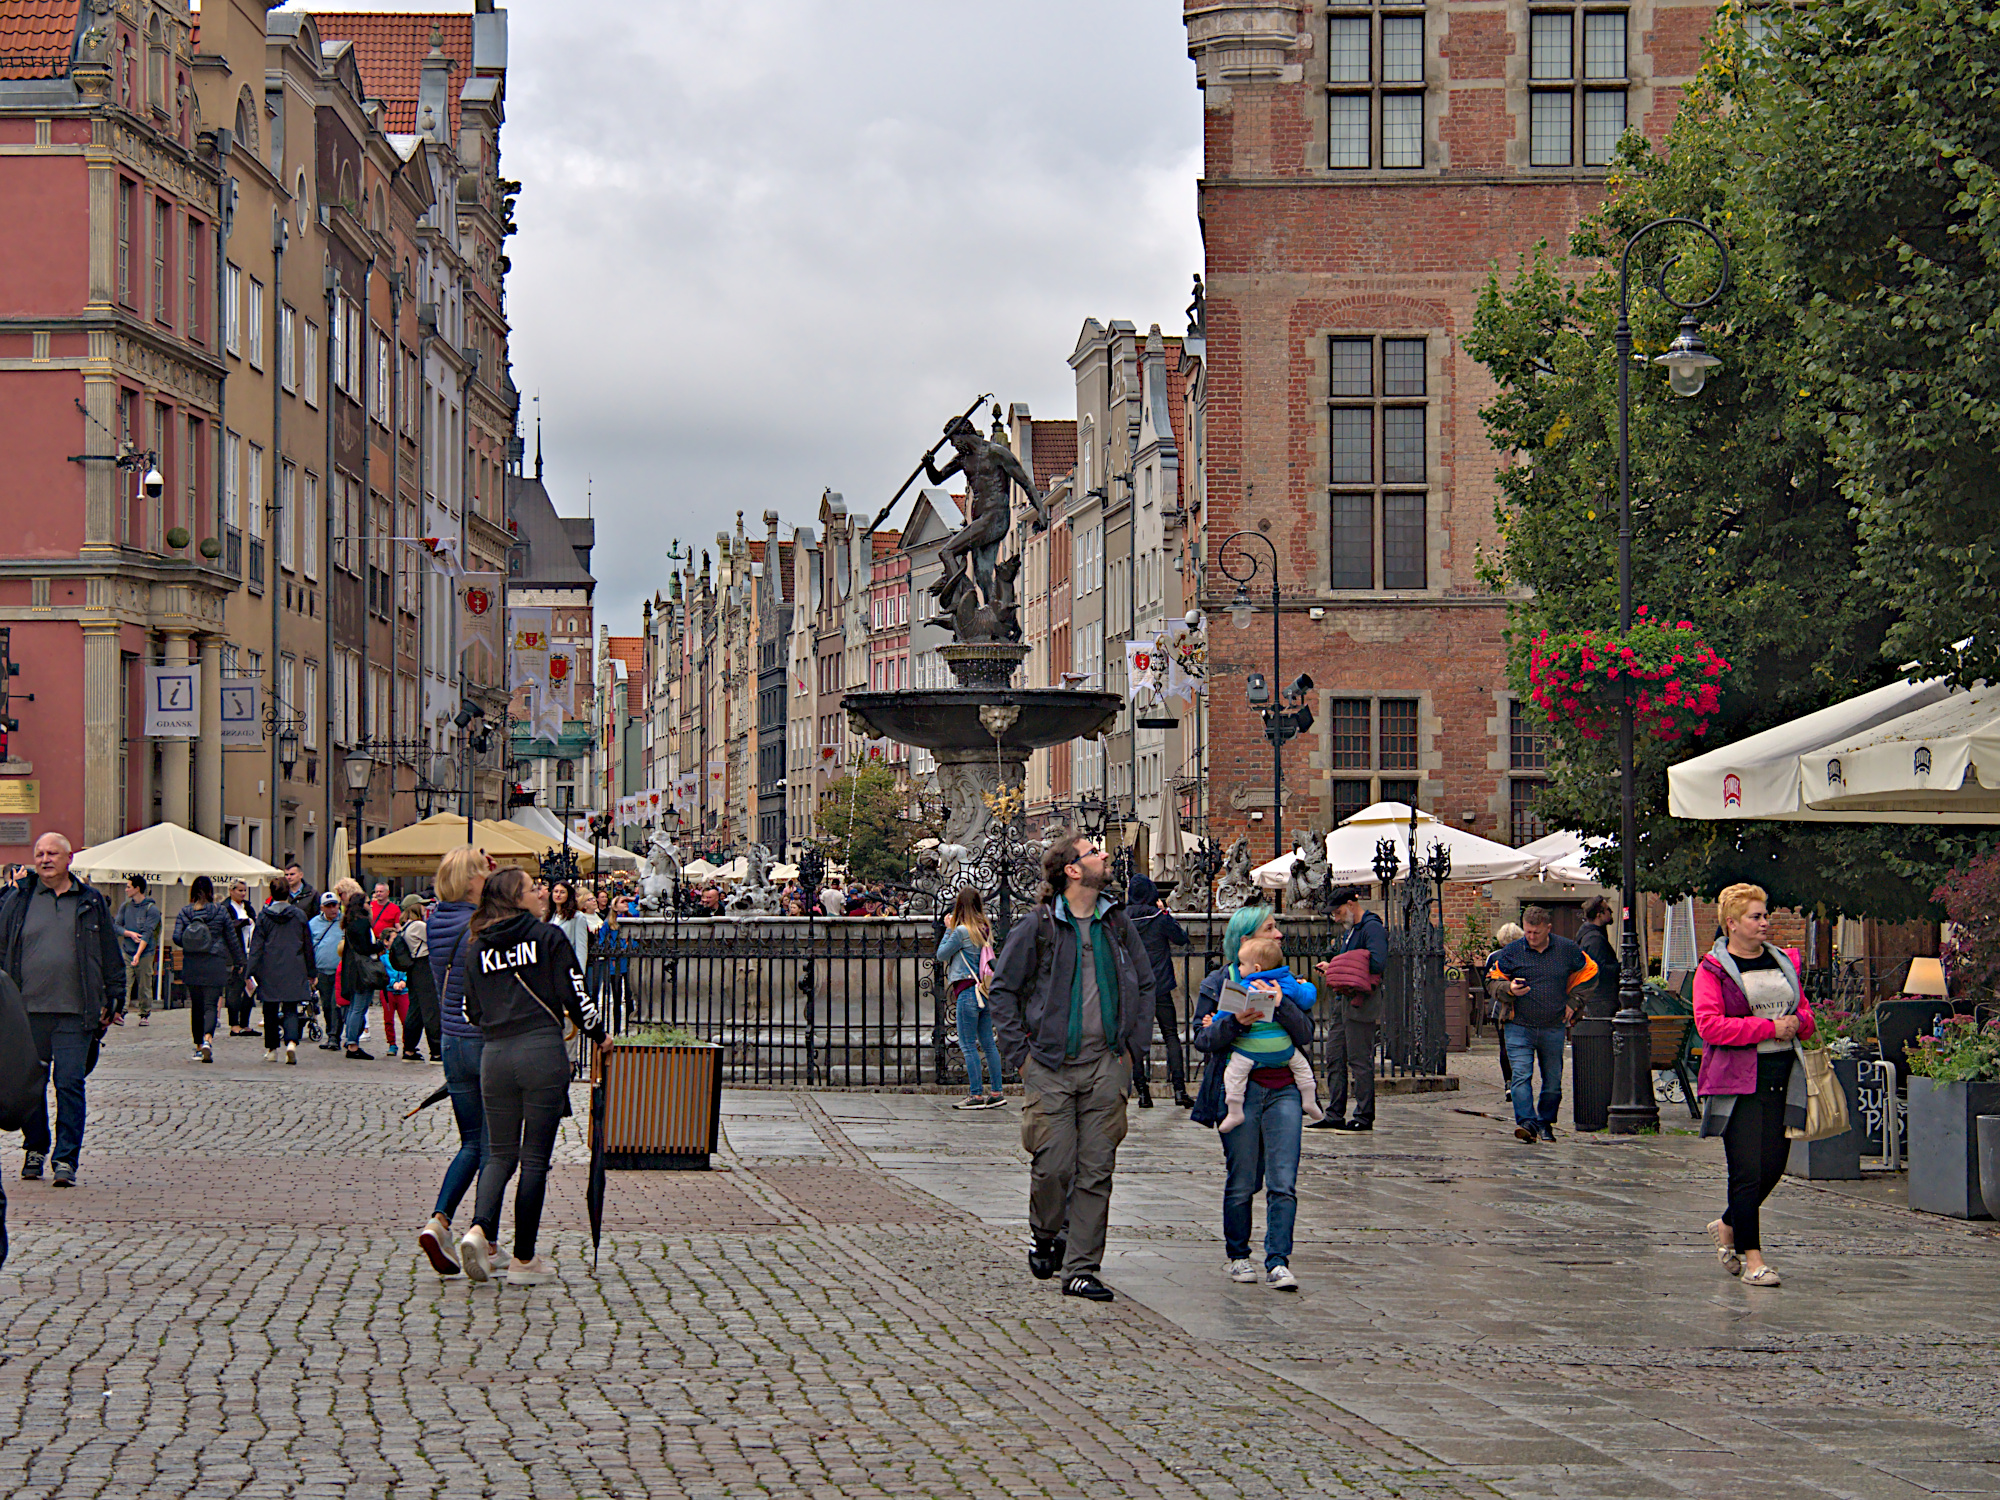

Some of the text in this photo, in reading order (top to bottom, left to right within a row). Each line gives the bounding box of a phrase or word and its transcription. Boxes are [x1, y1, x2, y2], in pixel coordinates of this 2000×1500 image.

[156, 720, 193, 728] GDAŃSK
[480, 940, 538, 974] KLEIN
[568, 967, 600, 1031] JEANS
[1755, 1001, 1776, 1010] WANT
[1776, 1000, 1784, 1008] IT
